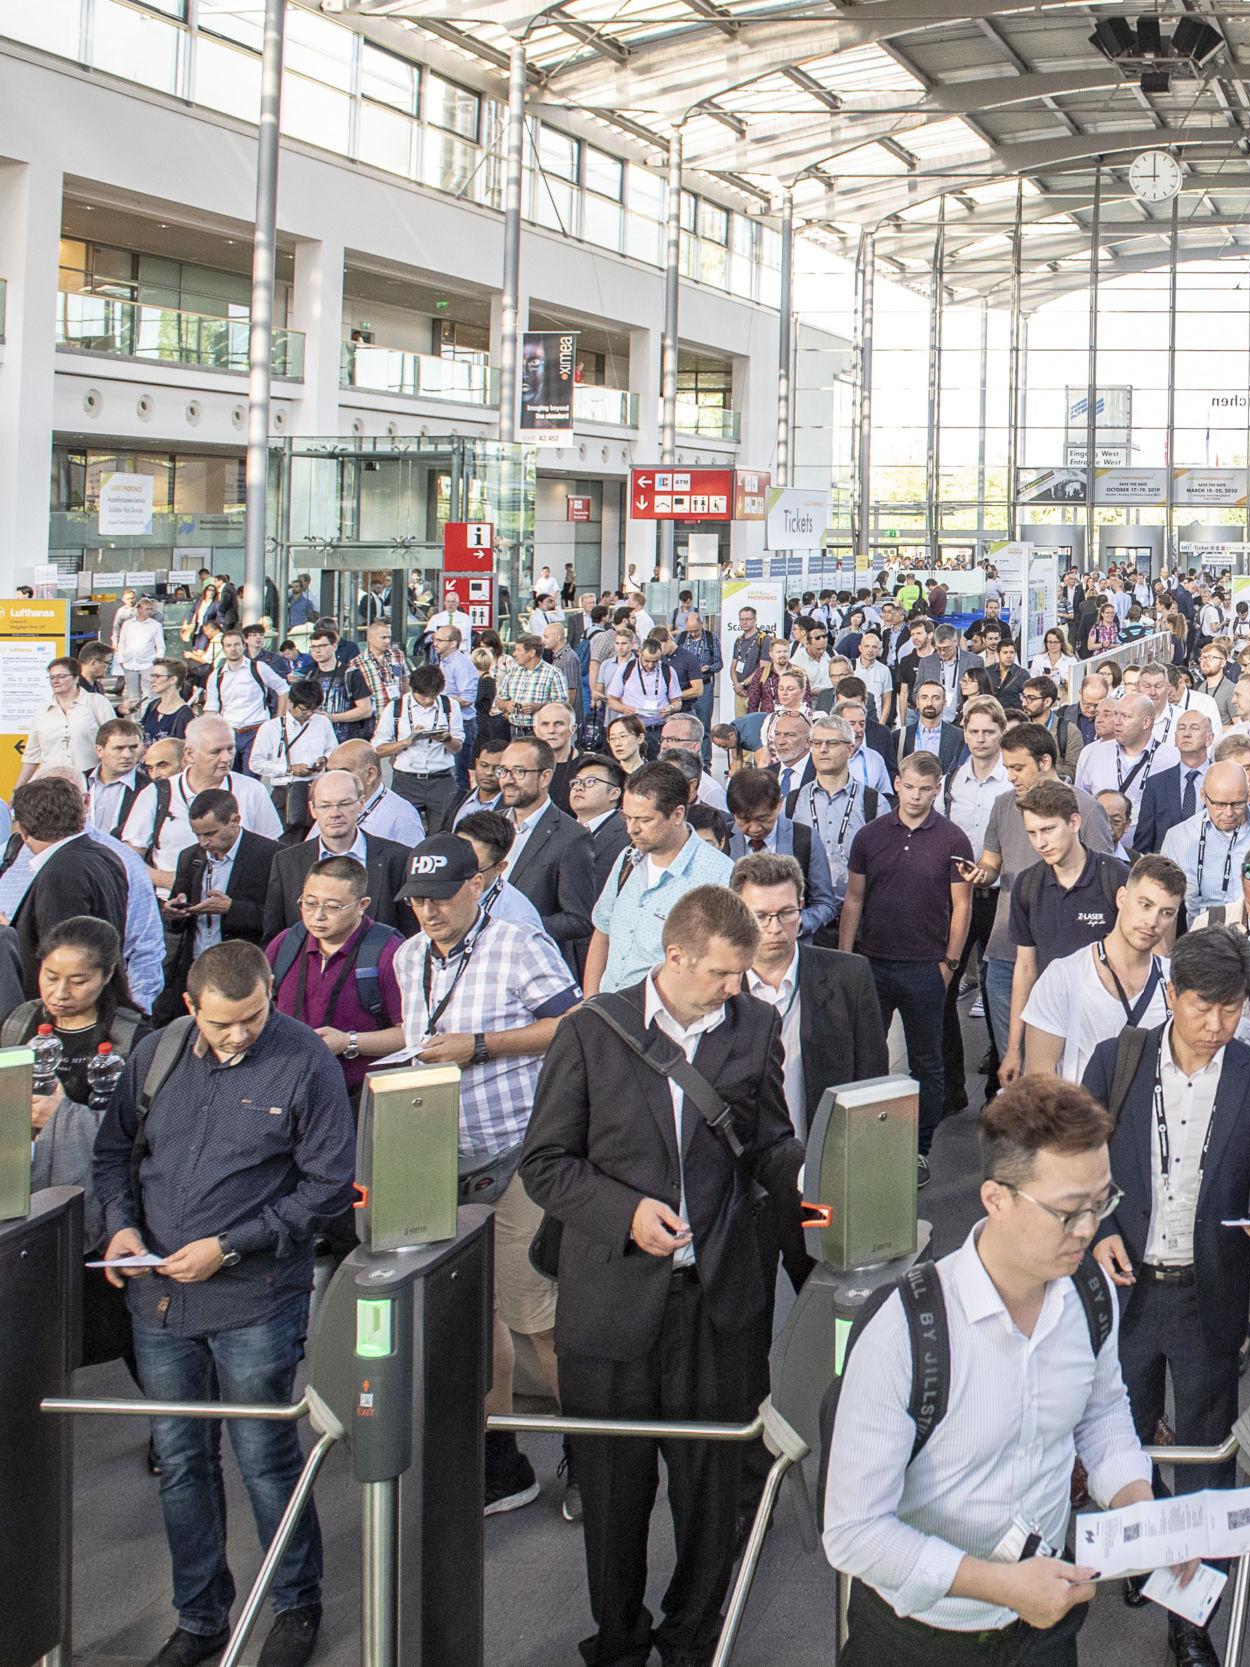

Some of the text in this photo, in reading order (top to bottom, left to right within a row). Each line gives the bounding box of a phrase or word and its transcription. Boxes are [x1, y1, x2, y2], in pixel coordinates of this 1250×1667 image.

[560, 336, 573, 375] ximea
[1069, 450, 1098, 459] Eingag
[783, 508, 813, 533] Tickets
[10, 608, 55, 618] Lufthansa
[727, 623, 743, 632] Sca
[410, 855, 449, 875] HDP
[1077, 912, 1105, 920] Z-LASER
[1088, 1276, 1105, 1302] BY
[906, 1267, 927, 1299] JILL
[920, 1312, 937, 1340] BY
[357, 1407, 374, 1417] EXIT
